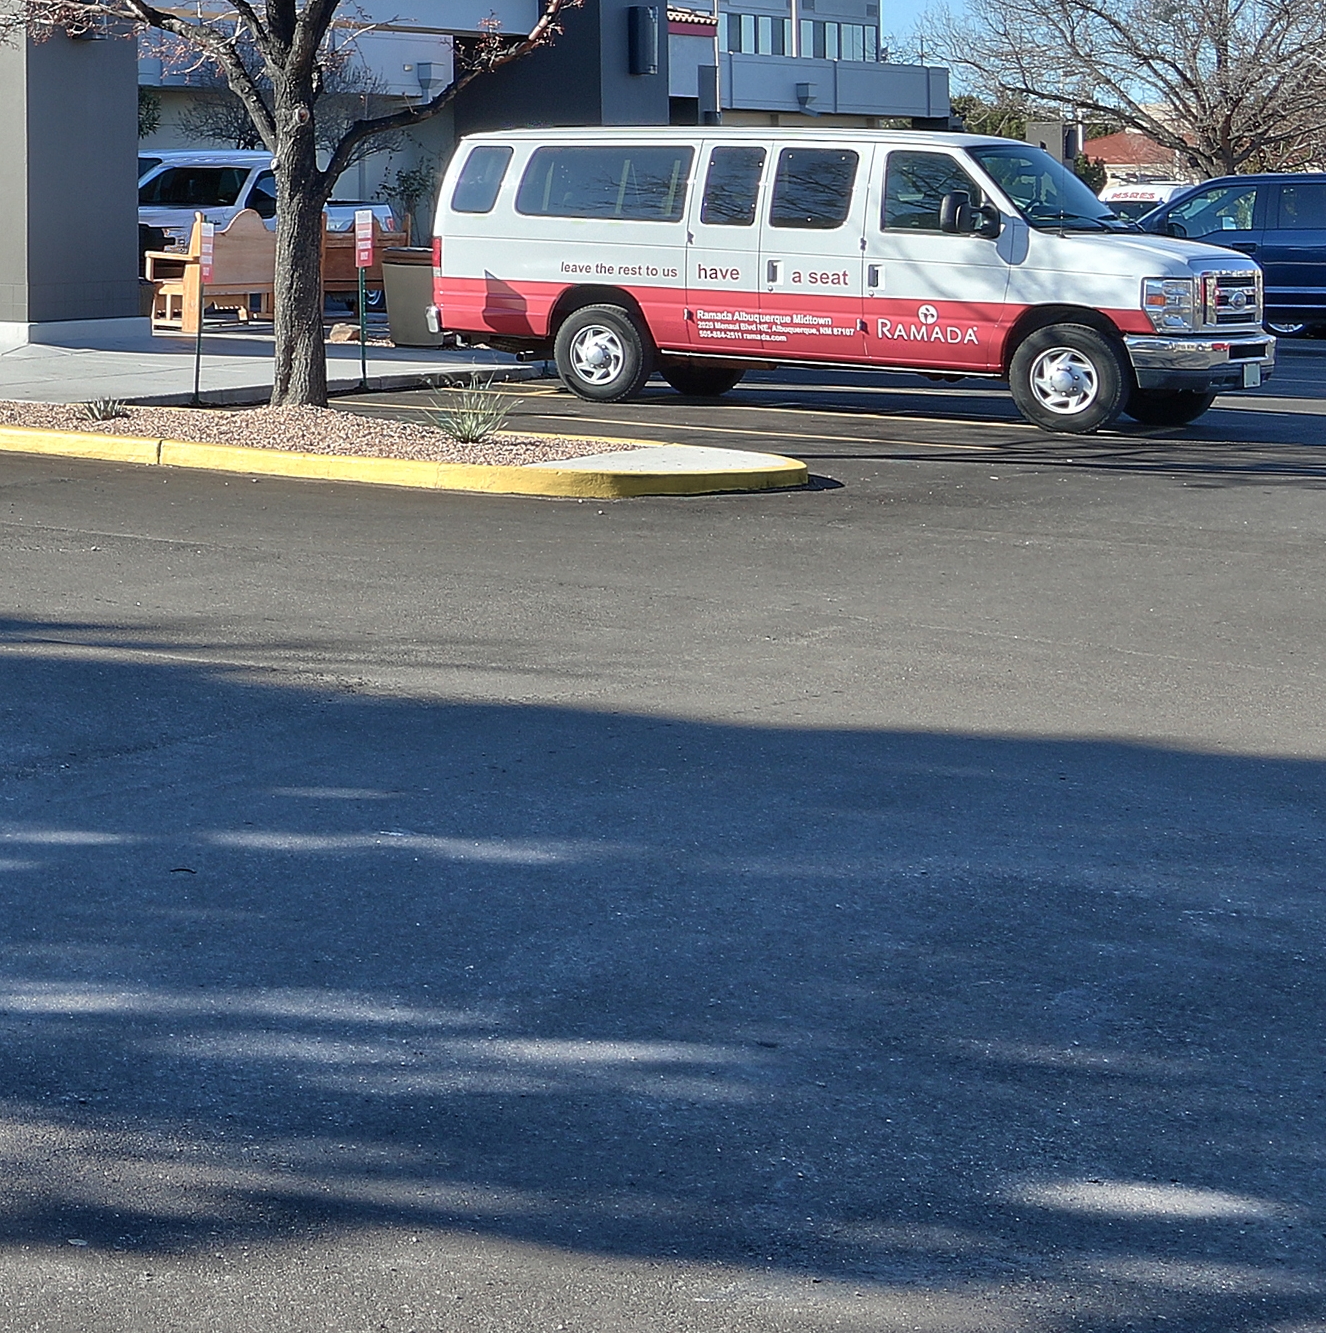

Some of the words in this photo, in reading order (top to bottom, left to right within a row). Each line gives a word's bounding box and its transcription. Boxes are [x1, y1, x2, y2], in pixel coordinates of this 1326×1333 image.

[560, 261, 592, 273] leave
[595, 263, 614, 274] the
[618, 265, 642, 276] rest
[646, 266, 658, 277] to
[662, 268, 678, 278] us
[697, 263, 740, 281] have
[791, 271, 802, 284] a
[808, 270, 849, 286] seat
[696, 310, 732, 321] Ramada
[733, 311, 791, 324] Albuquerque
[792, 314, 832, 325] Midtown
[740, 322, 756, 331] Blvd
[771, 325, 820, 335] Albuquerque,
[820, 327, 832, 335] NM
[877, 318, 979, 345] RAMADA
[743, 332, 787, 342] ramada.com
